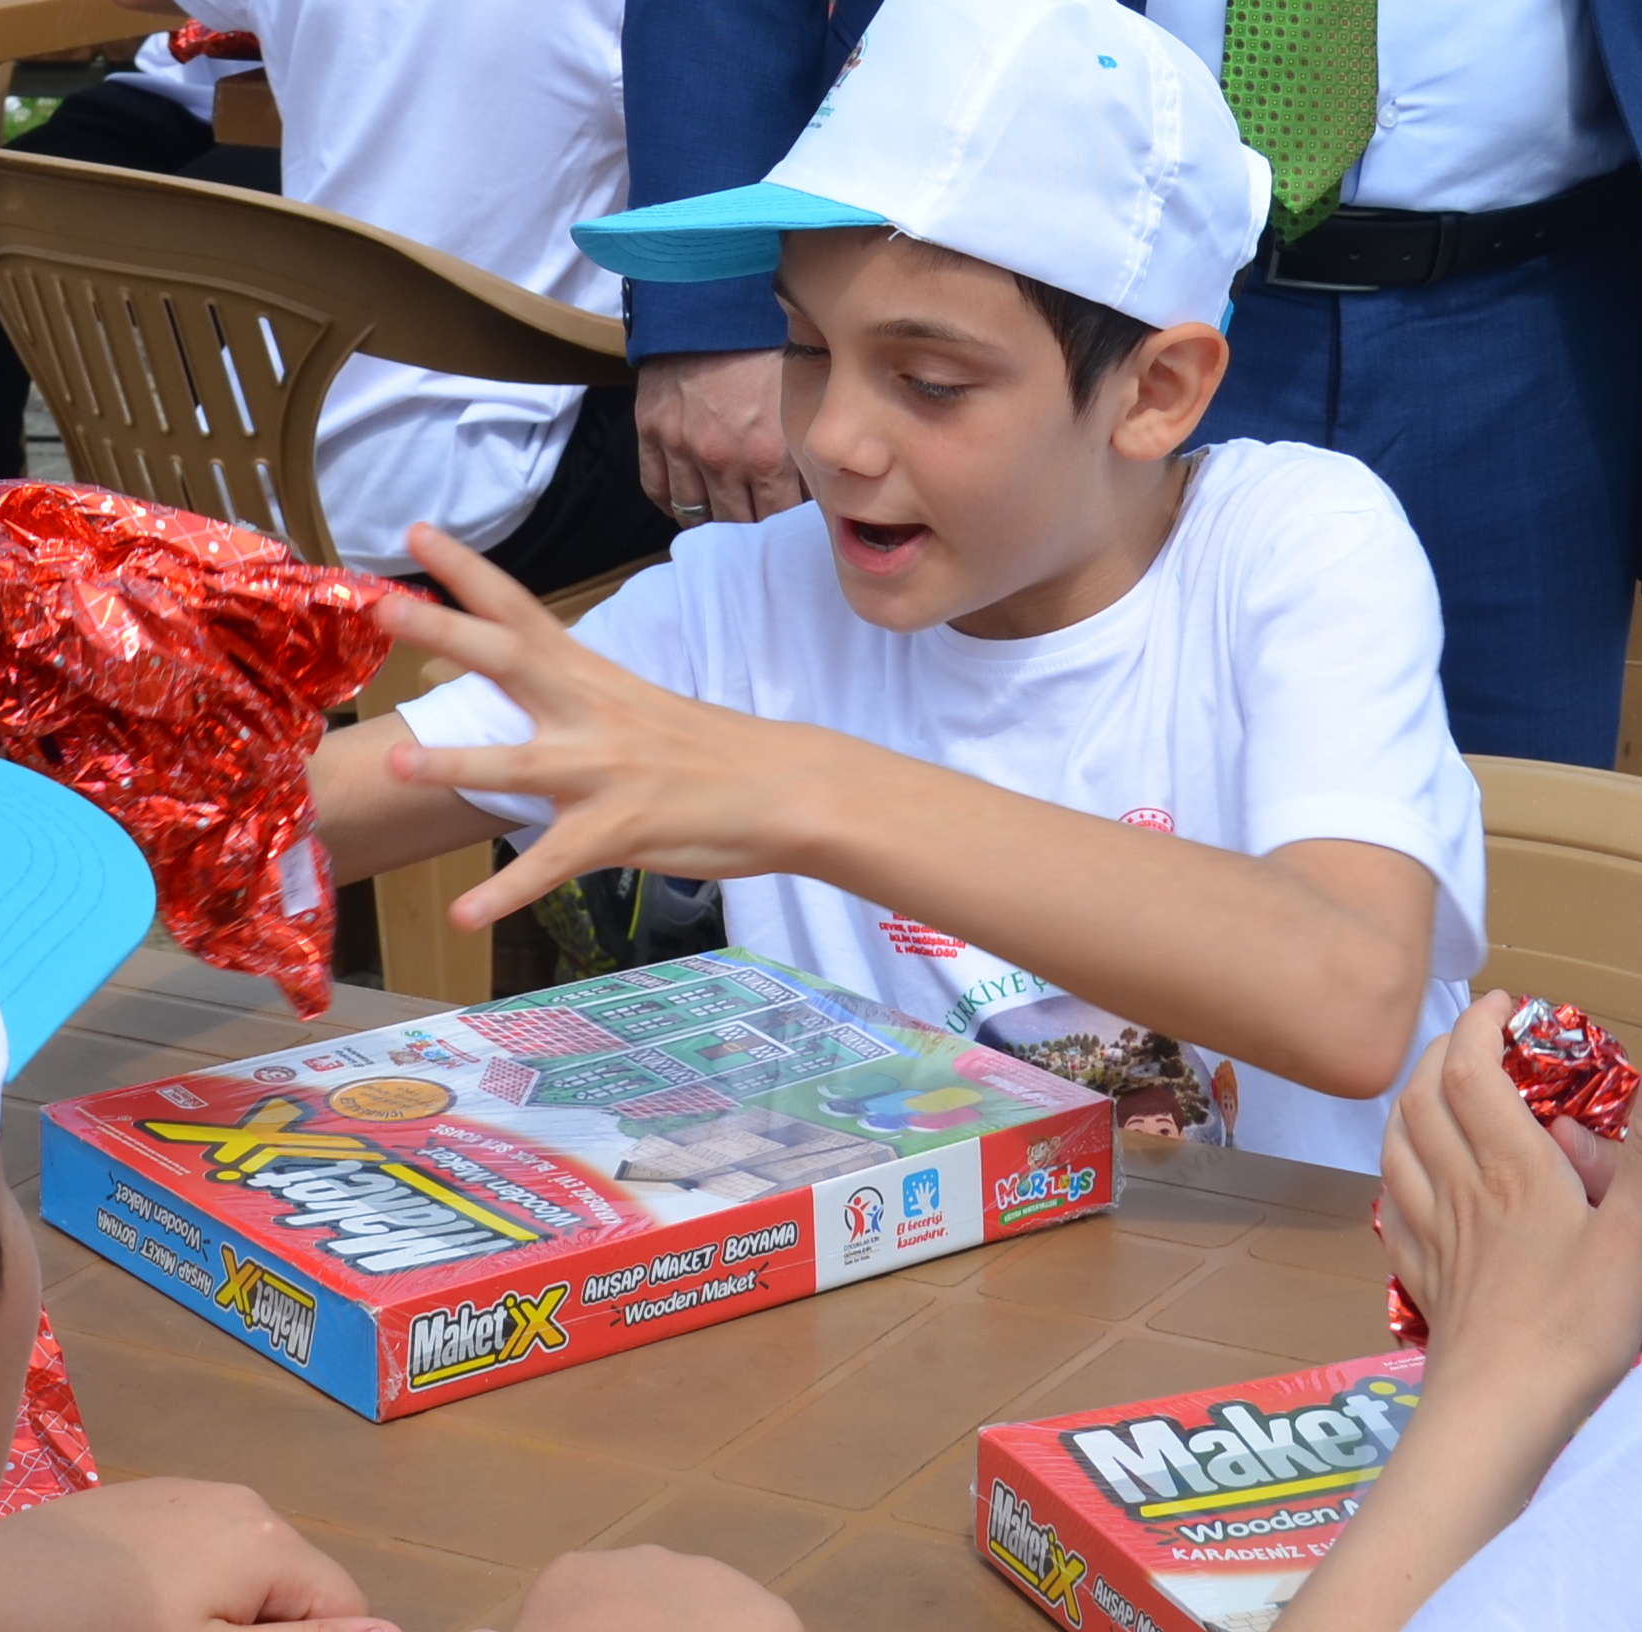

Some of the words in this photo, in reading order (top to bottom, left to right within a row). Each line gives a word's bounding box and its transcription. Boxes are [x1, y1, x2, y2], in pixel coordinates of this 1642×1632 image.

[945, 971, 1027, 1035] ÜRKİYE
[417, 1146, 492, 1184] Maket
[115, 1180, 153, 1220] Maket
[486, 1176, 582, 1228] Wooden
[98, 1207, 139, 1251] BOYAMA
[153, 1207, 202, 1249] Wooden
[907, 1210, 944, 1232] becerisi
[140, 1240, 178, 1277] MAKET
[177, 1261, 213, 1297] AHŞAP
[584, 1267, 646, 1304] AHŞAP
[650, 1246, 715, 1286] MAKET
[722, 1222, 797, 1264] BOYAMA
[623, 1290, 698, 1327] Wooden
[700, 1269, 757, 1305] Maket
[1180, 1506, 1340, 1545] Wooden
[1172, 1542, 1306, 1564] KARADENİZ
[1094, 1577, 1135, 1626] AHŞAP
